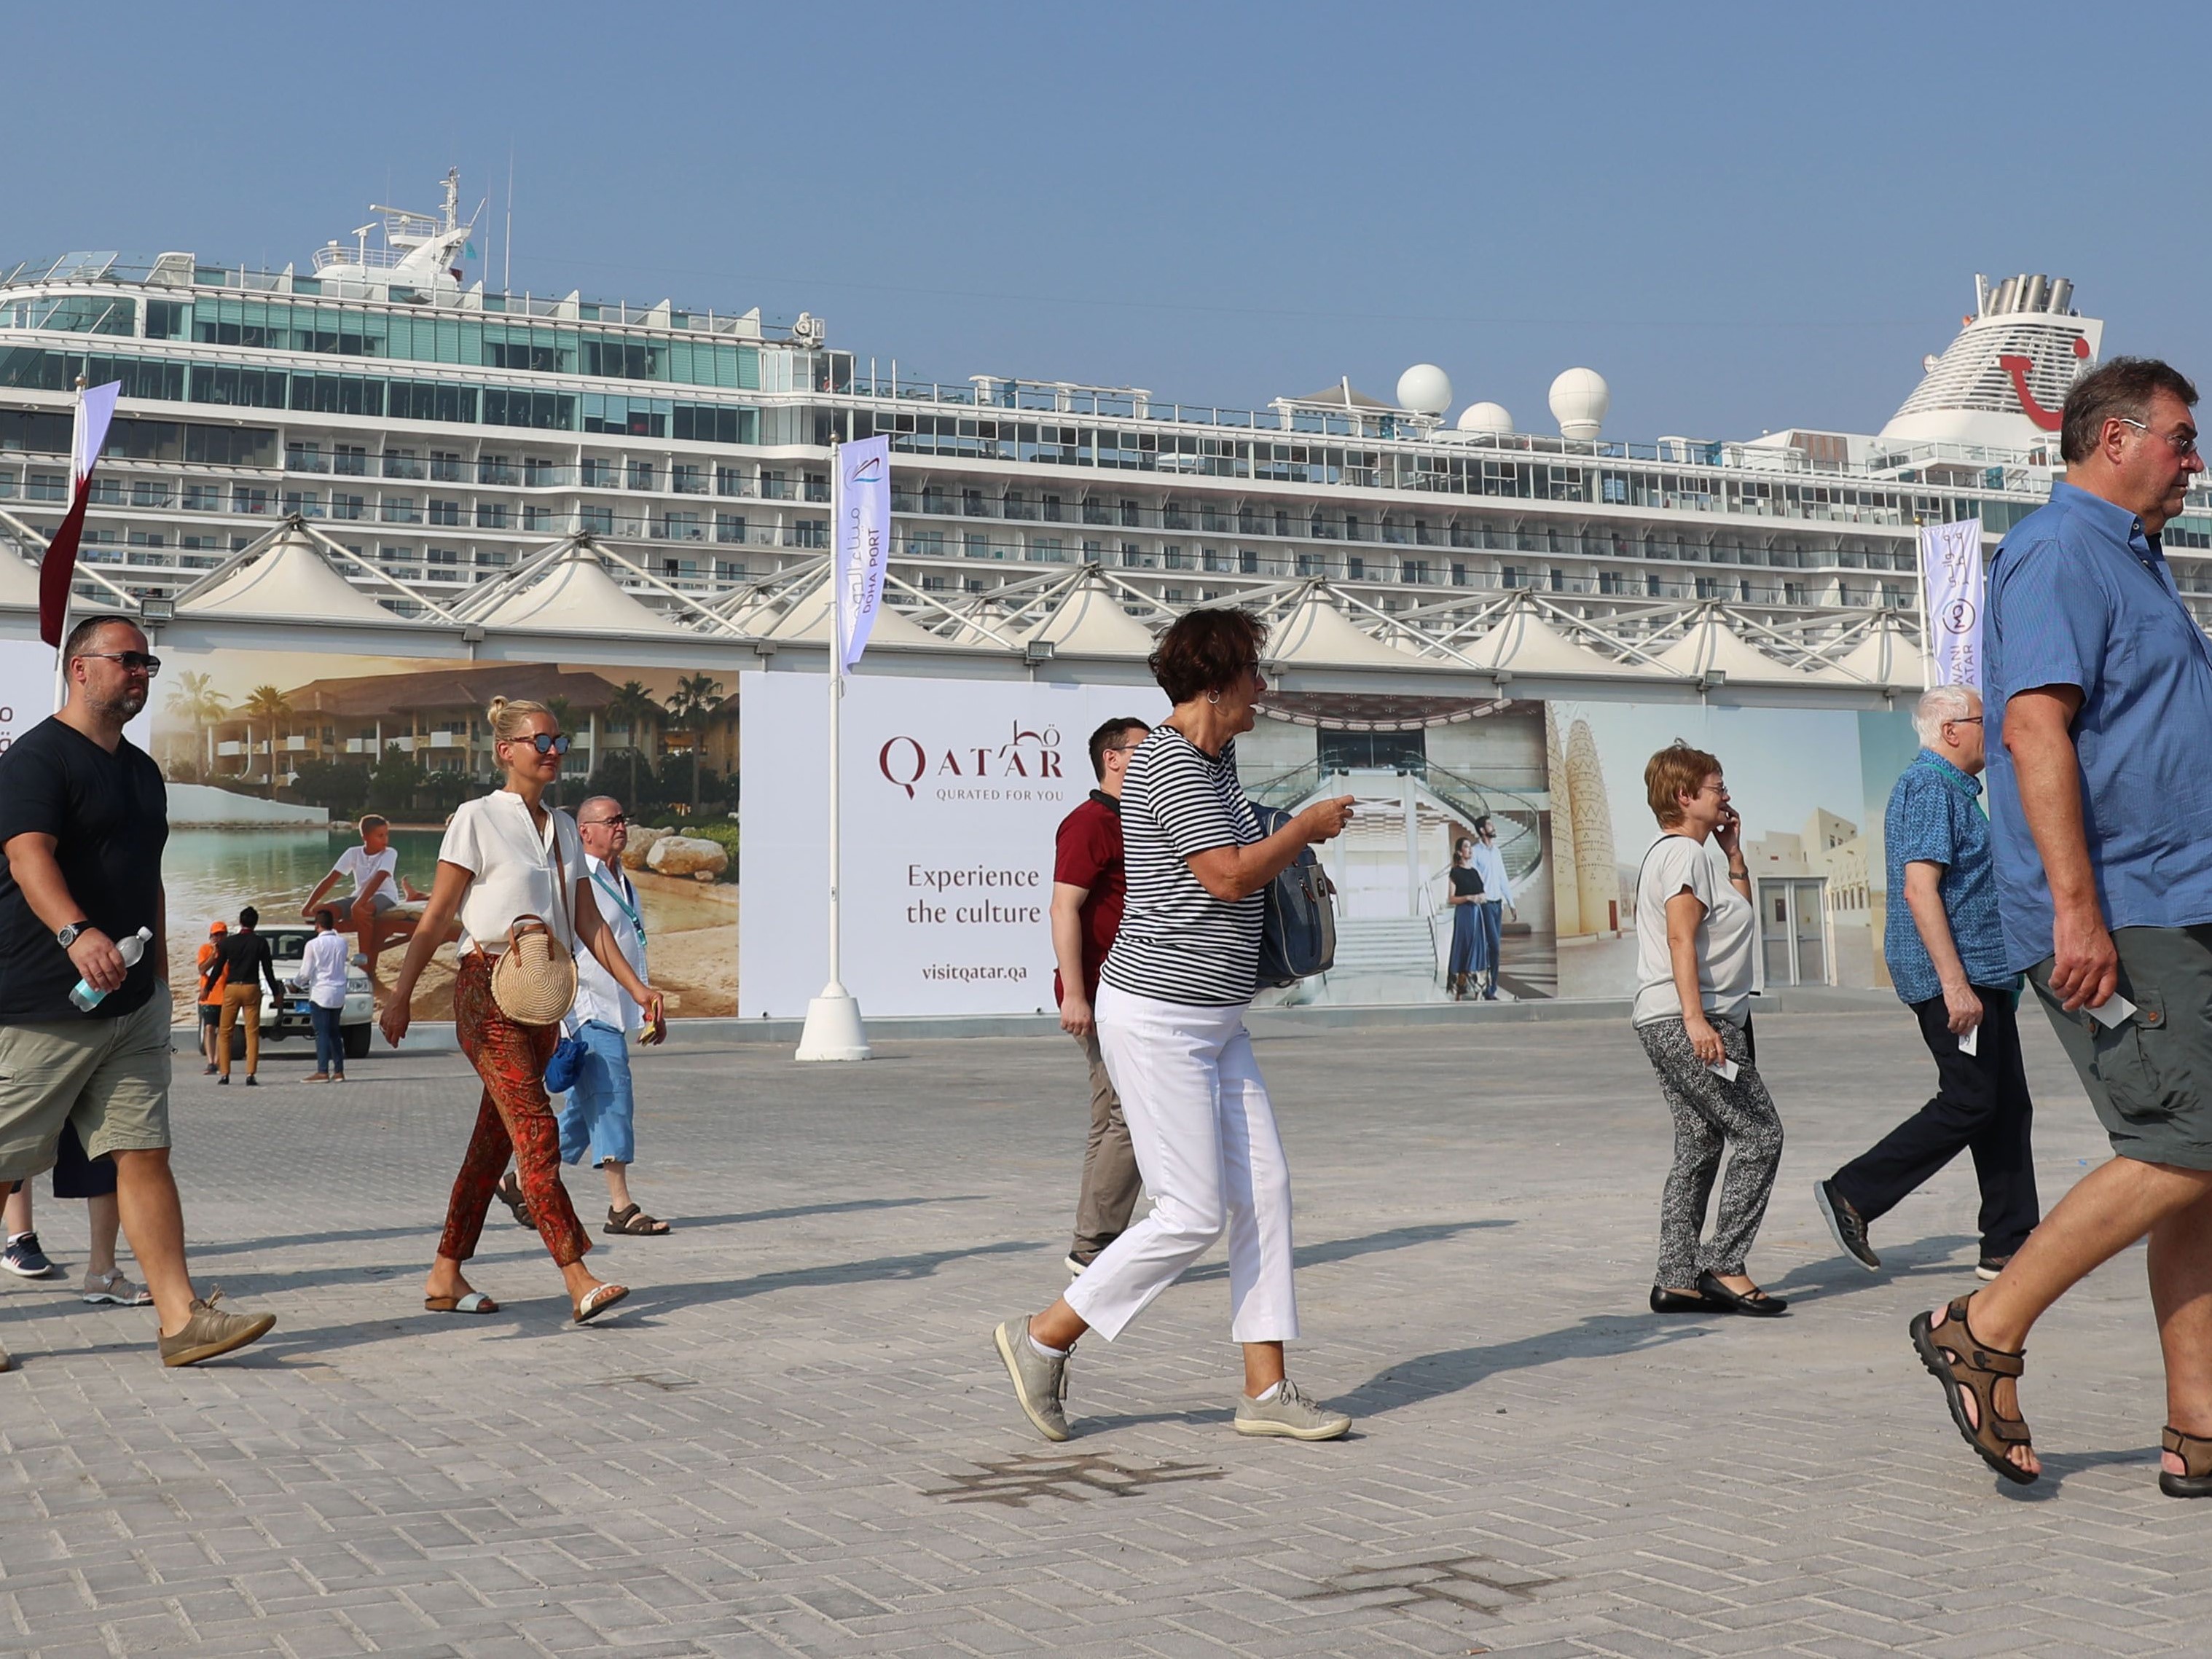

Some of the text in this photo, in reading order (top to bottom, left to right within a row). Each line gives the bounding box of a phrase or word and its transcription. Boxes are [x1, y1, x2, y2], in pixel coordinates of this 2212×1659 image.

[863, 528, 879, 613] DOHA PORT
[1950, 646, 1963, 685] WANI
[1964, 644, 1974, 685] ATAR
[879, 736, 1063, 801] QATAR
[936, 789, 1064, 801] QURATED FOR YOU
[909, 864, 1040, 893] Experience
[907, 898, 1041, 923] the culture
[922, 964, 1027, 983] visitqatar.qa
